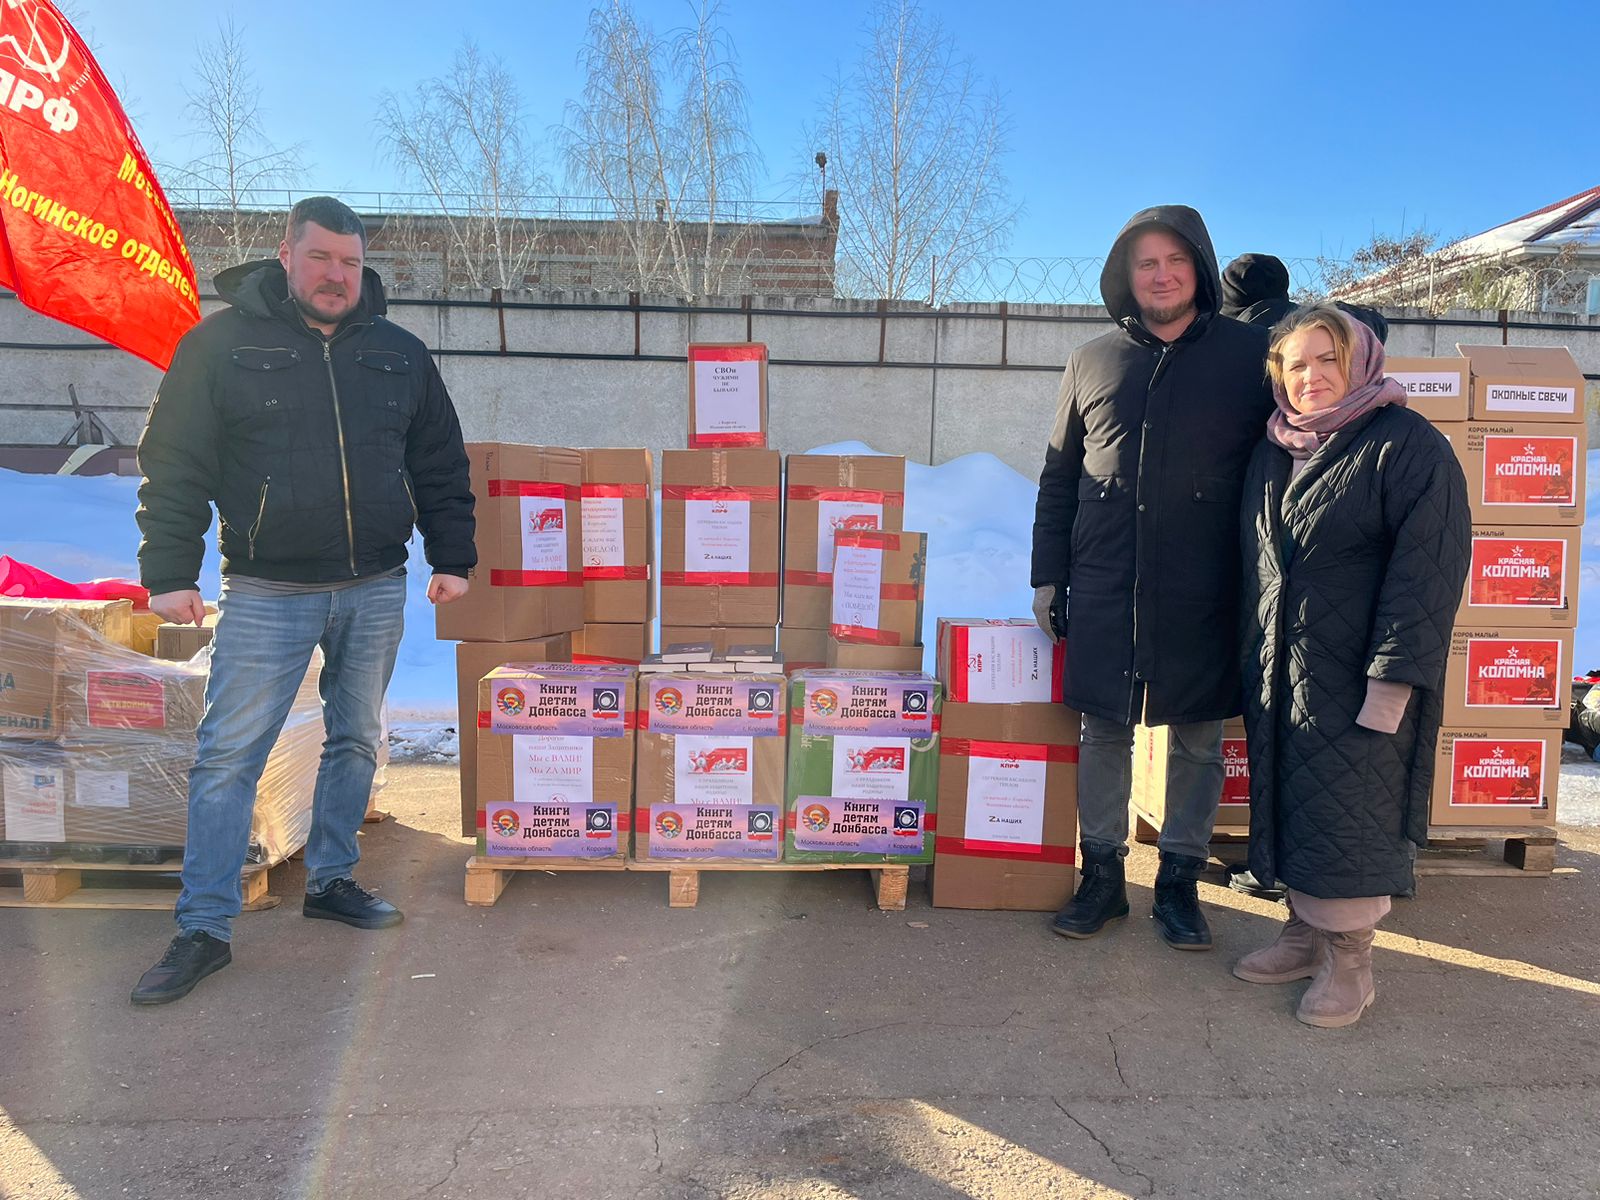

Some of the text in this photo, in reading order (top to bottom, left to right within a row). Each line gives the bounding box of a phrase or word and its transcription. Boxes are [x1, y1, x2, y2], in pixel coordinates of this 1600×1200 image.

[0, 68, 79, 134] ПРФ
[1, 169, 198, 307] Ногинское отделен
[1419, 382, 1452, 392] СВЕЧИ
[1491, 390, 1568, 402] ОКОПНЫЕ СВЕЧИ
[1490, 426, 1514, 434] МАЛЫЙ
[1495, 464, 1561, 476] КОЛОМНА
[1498, 557, 1535, 565] КРАСНАЯ
[1482, 566, 1550, 578] КОЛОМНА
[1478, 666, 1546, 678] КОЛОМНА
[539, 683, 577, 695] Книги
[696, 684, 733, 696] Книги
[852, 685, 888, 696] Книги
[538, 696, 576, 706] детям
[696, 696, 732, 706] детям
[850, 697, 886, 708] детям
[528, 706, 586, 718] Донбасса
[686, 706, 742, 718] Донбасса
[840, 707, 896, 719] Донбасса
[0, 716, 40, 729] ЕНАЛ
[1464, 766, 1530, 778] КОЛОМНА
[533, 806, 570, 817] Книги
[696, 806, 732, 818] Книги
[844, 802, 880, 813] Книги
[532, 818, 570, 828] детям
[696, 818, 732, 829] детям
[842, 813, 878, 824] детям
[523, 828, 580, 839] Донбасса
[686, 829, 742, 841] Донбасса
[832, 823, 888, 836] Донбасса
